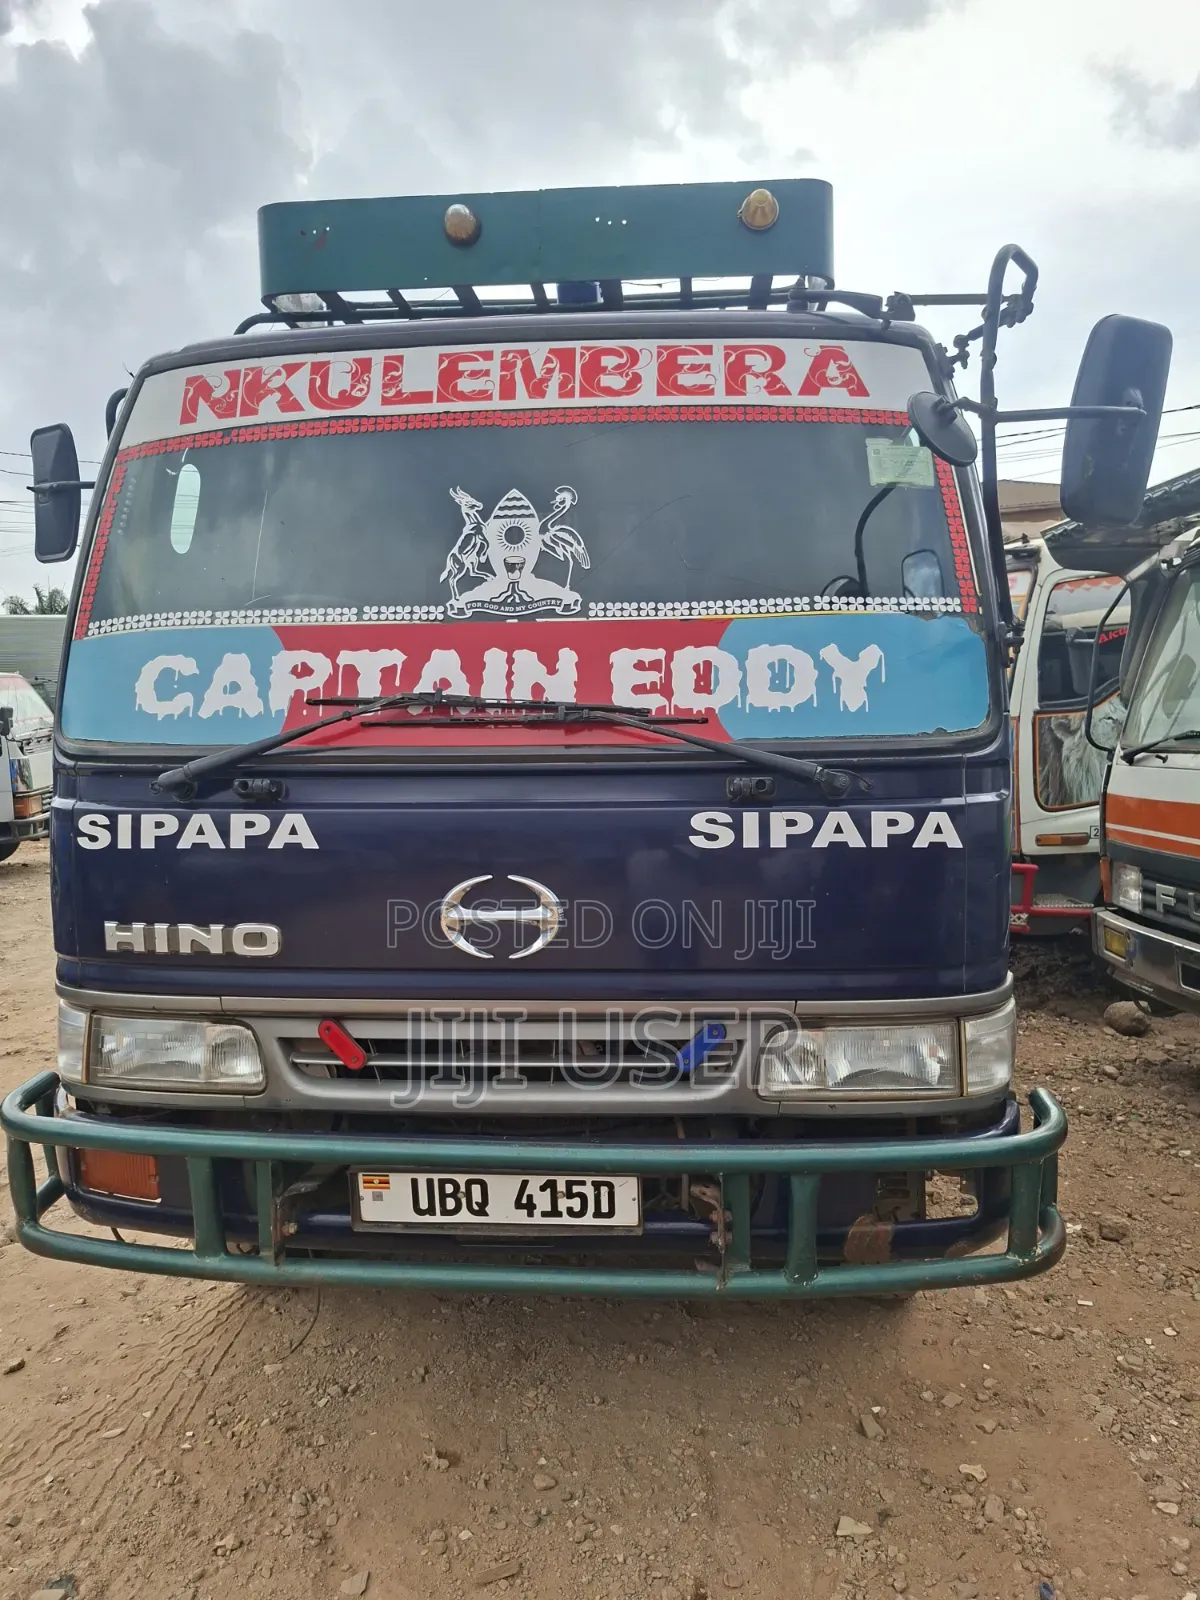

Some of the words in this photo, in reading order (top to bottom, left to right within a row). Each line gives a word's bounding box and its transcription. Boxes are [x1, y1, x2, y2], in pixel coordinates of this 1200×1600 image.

[179, 344, 870, 426] NKULEMBERA
[466, 600, 482, 609] FOR
[484, 602, 499, 611] GOD
[516, 604, 526, 612] MY
[527, 600, 562, 610] COUNTRY
[134, 647, 578, 720] CAPTAIN
[609, 643, 886, 715] EDDY
[77, 813, 320, 850] SIPAPA
[688, 811, 964, 849] SIPAPA
[104, 920, 282, 957] HINO
[410, 1177, 490, 1218] UBQ
[513, 1179, 616, 1219] 415D
